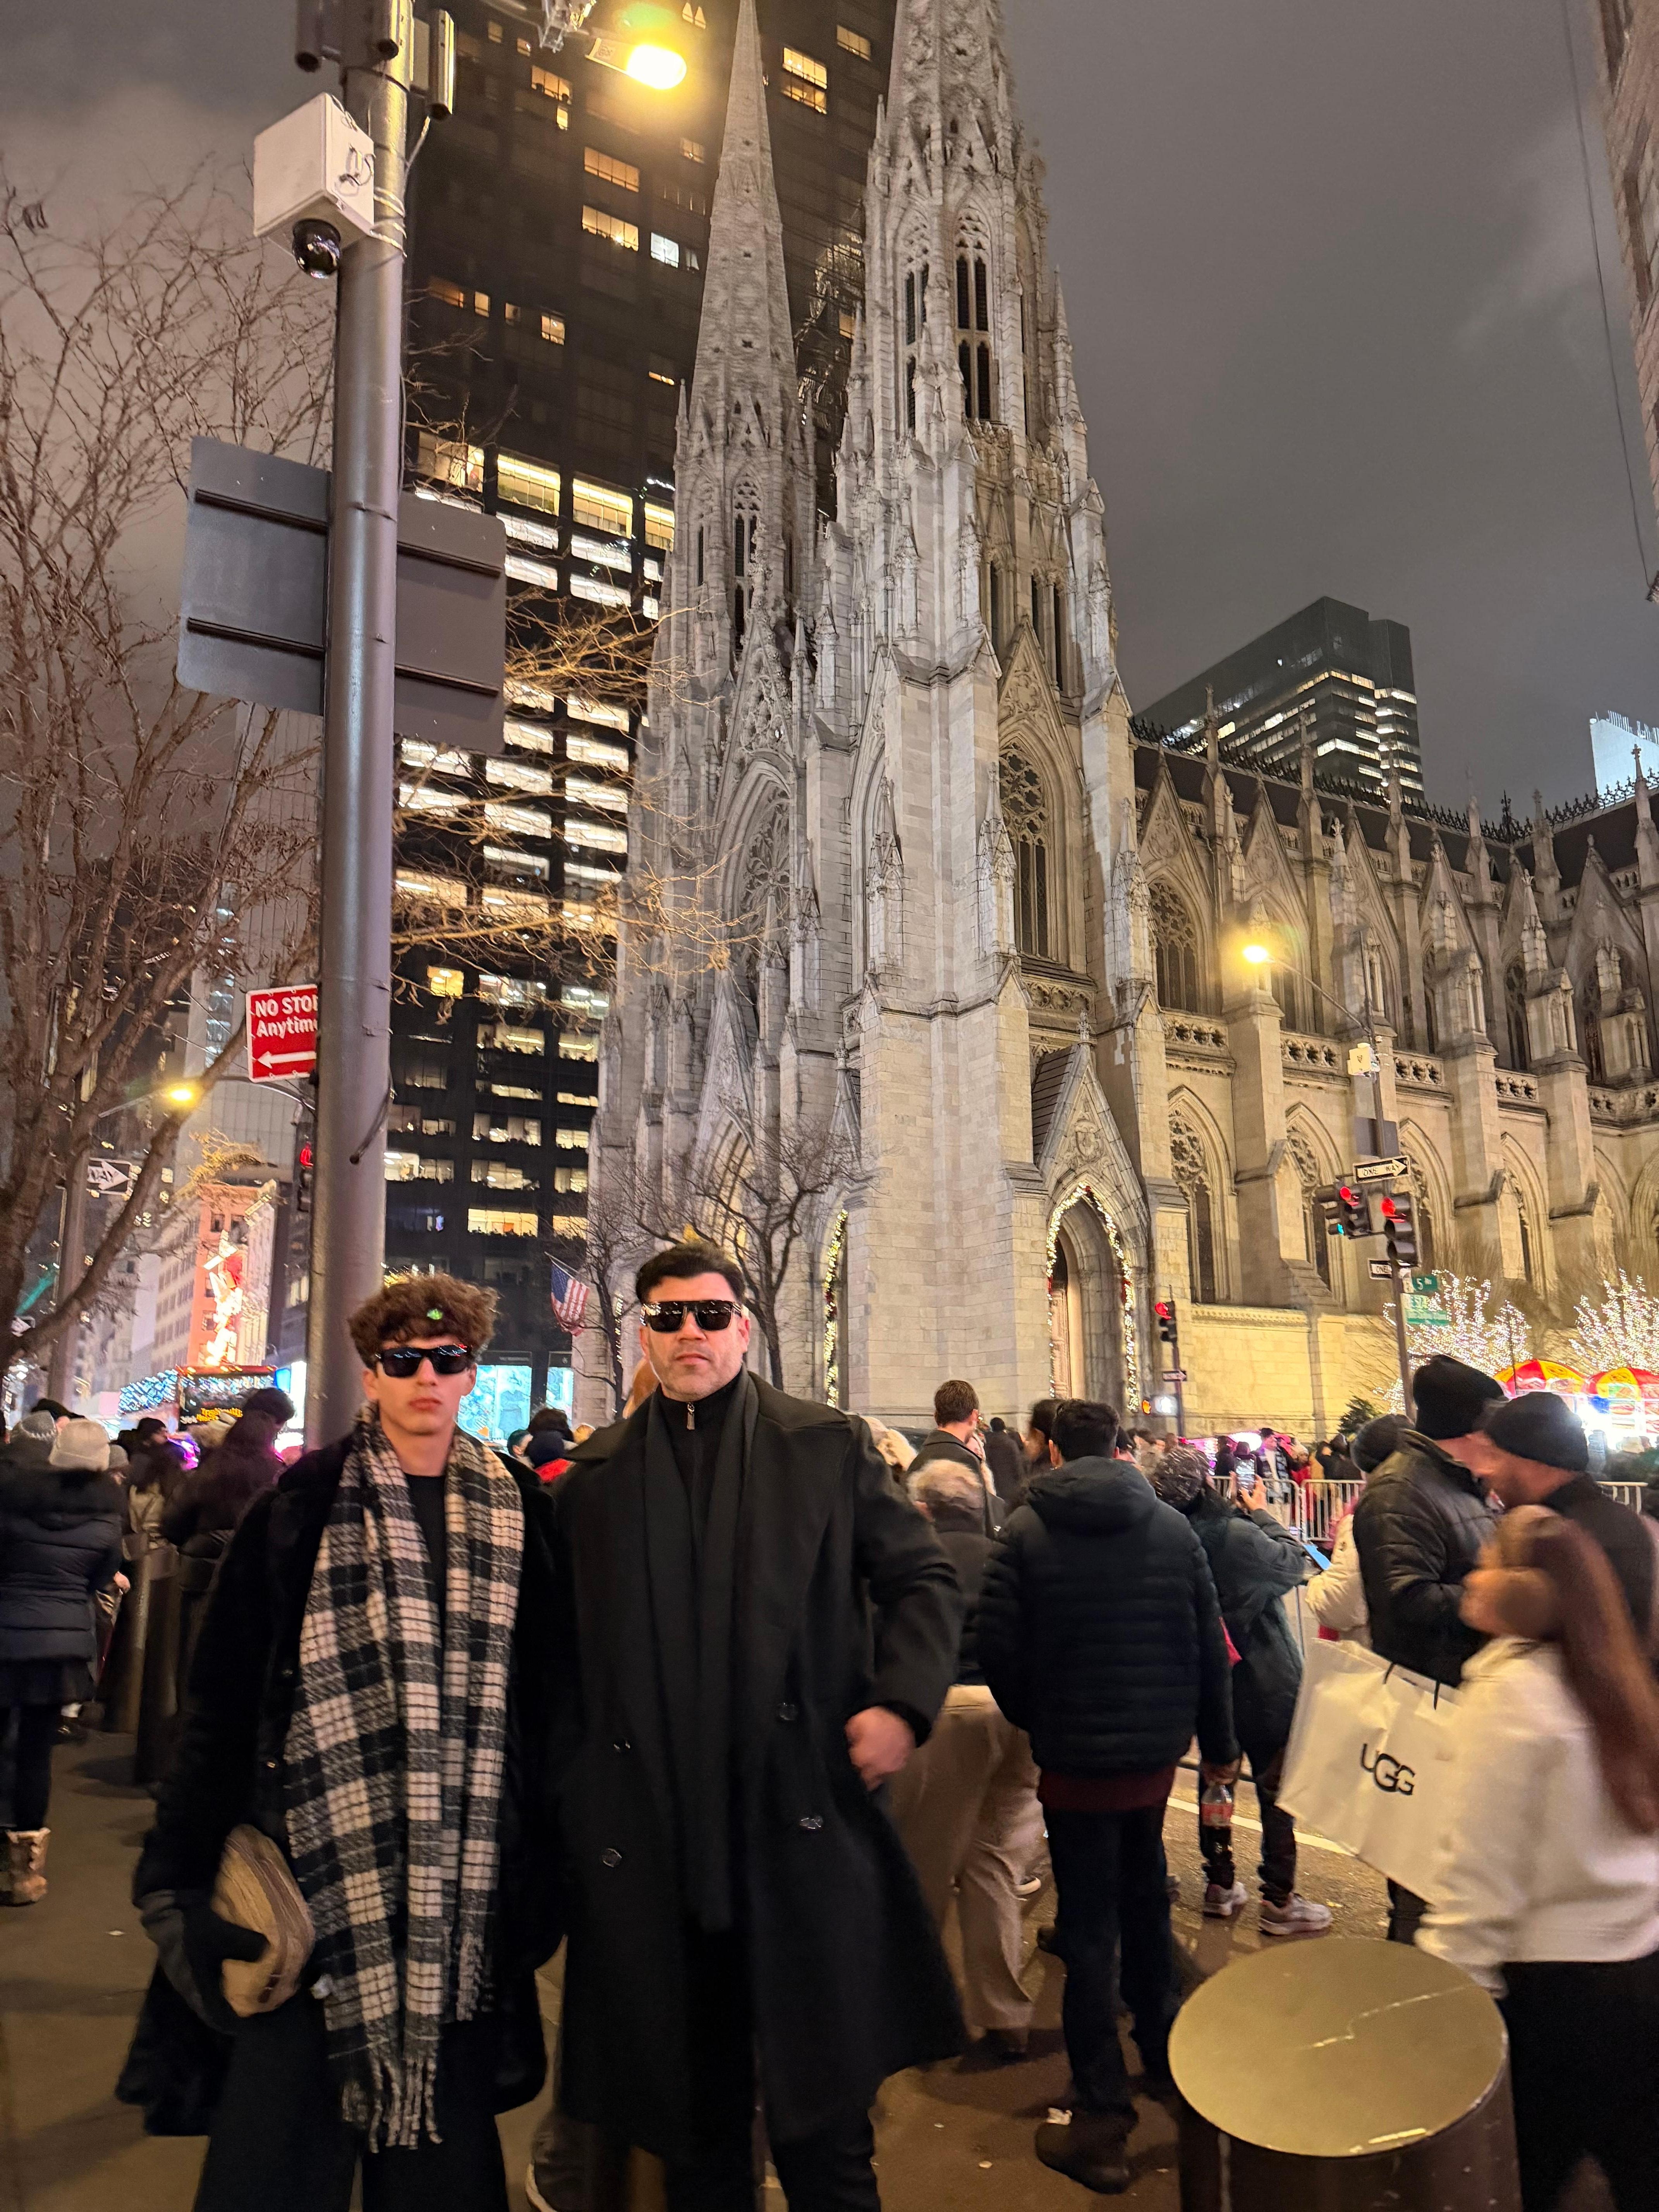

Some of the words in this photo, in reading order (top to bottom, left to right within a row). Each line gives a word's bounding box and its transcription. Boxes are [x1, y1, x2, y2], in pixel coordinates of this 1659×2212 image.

[255, 998, 279, 1018] NO
[1363, 1166, 1379, 1176] ONE
[1360, 1743, 1415, 1795] UGG
